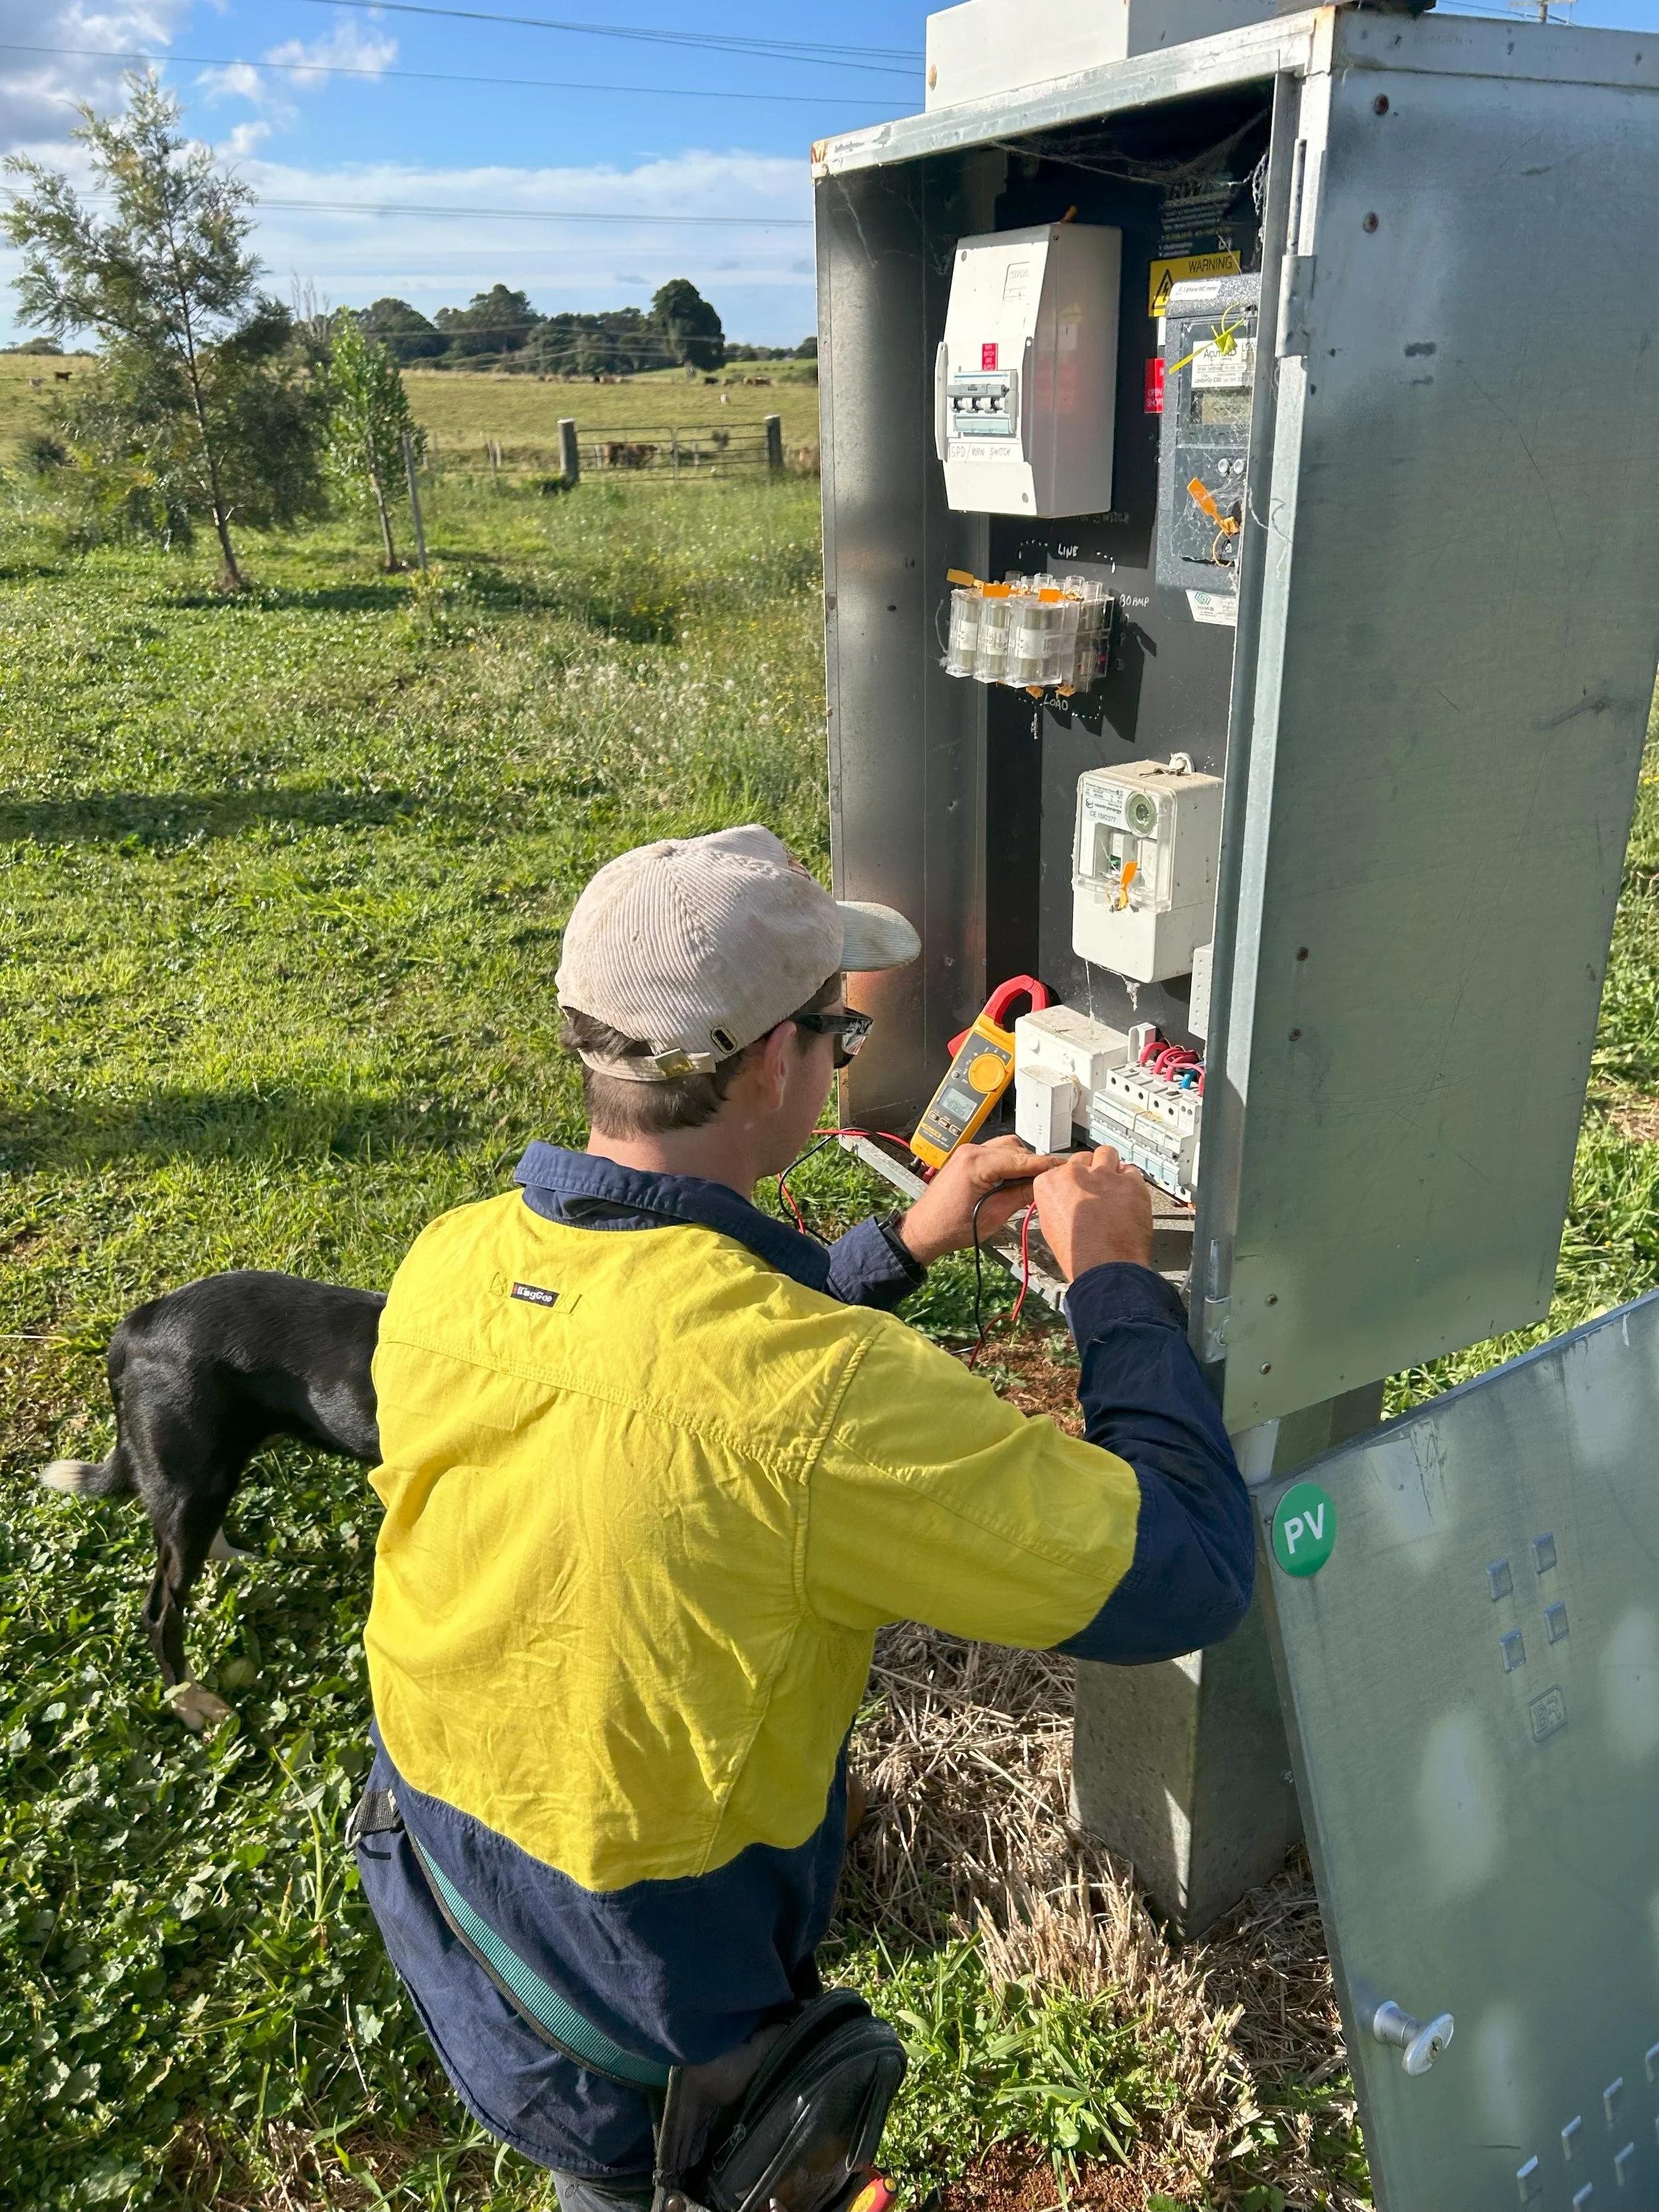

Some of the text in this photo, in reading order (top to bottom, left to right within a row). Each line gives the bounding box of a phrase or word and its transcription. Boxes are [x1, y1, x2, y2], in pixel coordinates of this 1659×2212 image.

[1189, 256, 1232, 273] WARNING
[1058, 544, 1079, 557] LINE
[1132, 597, 1149, 608] AMP
[1043, 694, 1068, 711] LOAD
[517, 1286, 553, 1303] KingGee
[1284, 1503, 1324, 1554] PV
